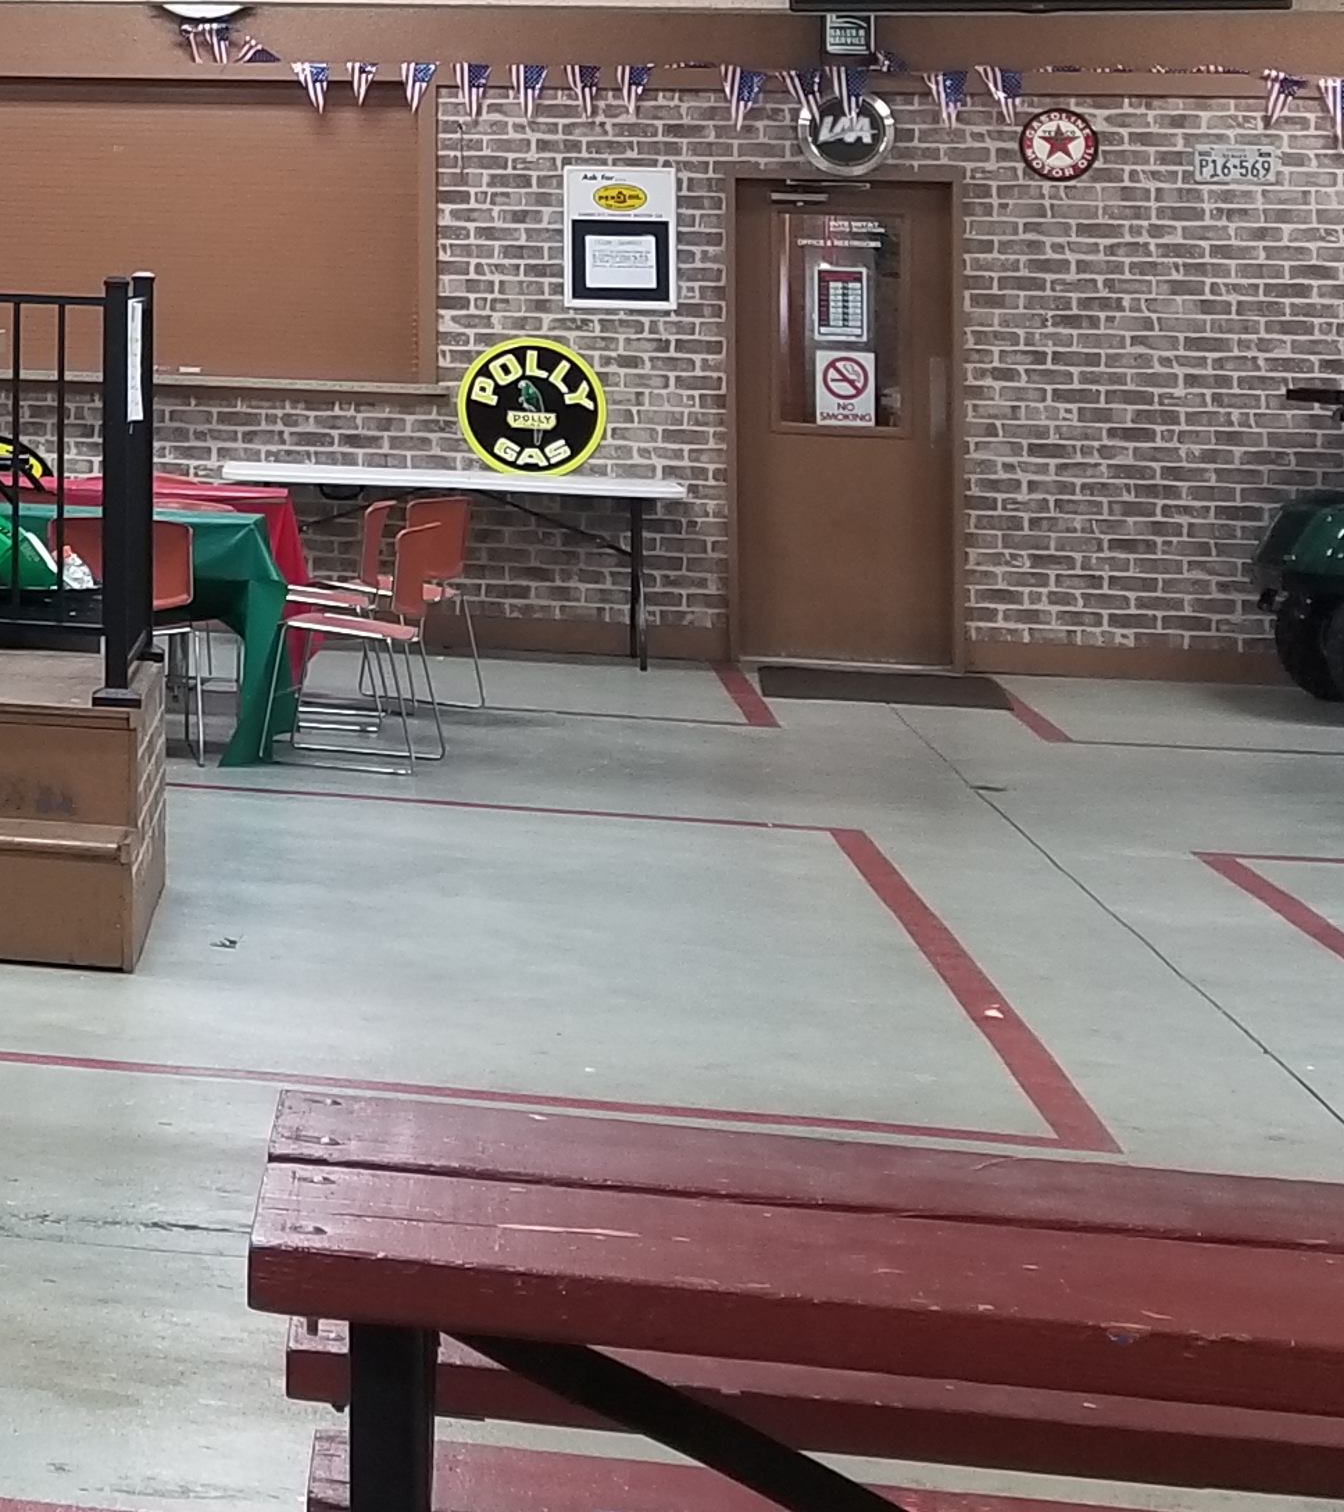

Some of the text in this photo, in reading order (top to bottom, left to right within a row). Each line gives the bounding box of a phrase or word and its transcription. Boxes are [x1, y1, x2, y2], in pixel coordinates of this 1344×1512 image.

[1026, 112, 1092, 139] GASOLINE
[1025, 147, 1095, 177] MOTOR OIL
[471, 350, 595, 411] POLLY
[513, 414, 552, 424] POLLY
[819, 411, 873, 423] SMOKING
[836, 402, 855, 412] NO
[493, 437, 572, 467] GAS
